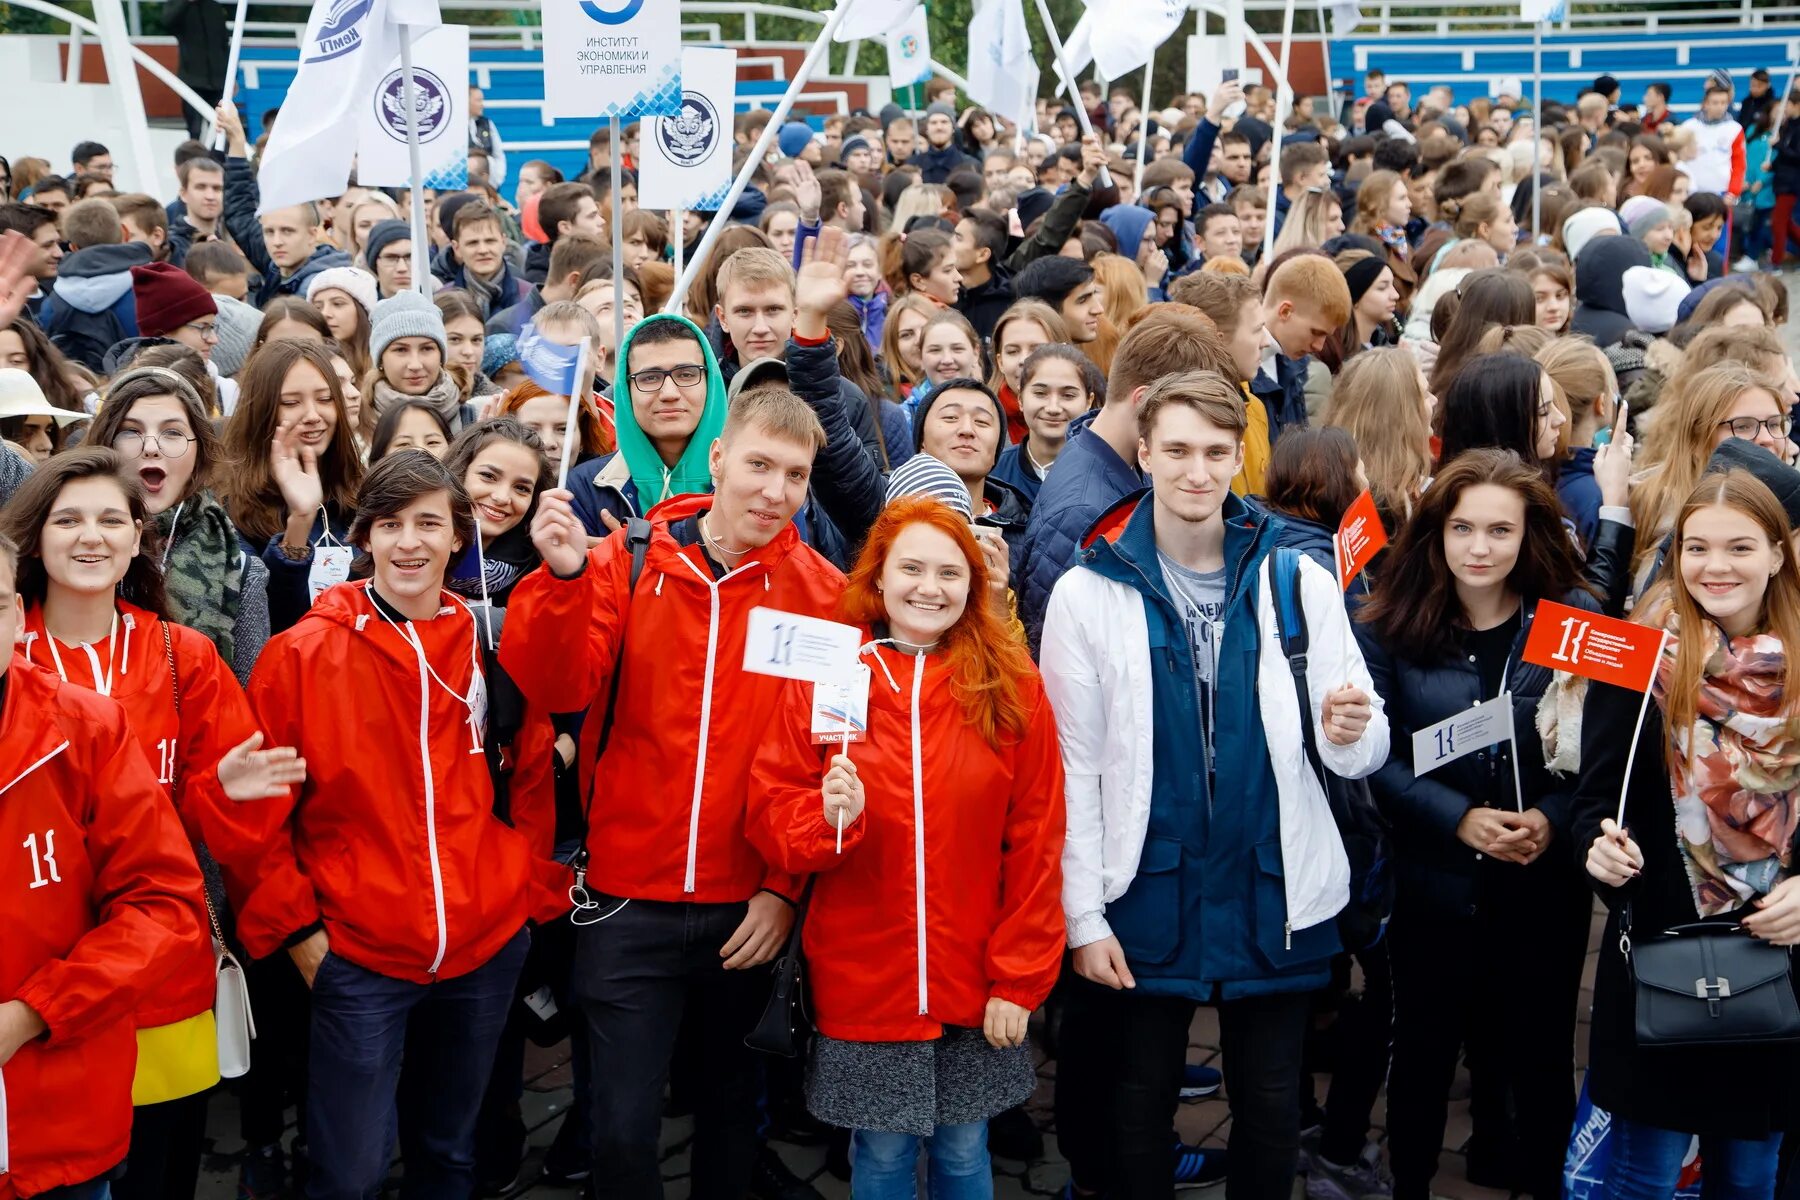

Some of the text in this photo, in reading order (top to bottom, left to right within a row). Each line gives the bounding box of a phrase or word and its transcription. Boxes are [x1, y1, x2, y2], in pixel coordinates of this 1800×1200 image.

[586, 36, 638, 47] ИНСТИТУТ
[577, 50, 649, 61] ЭКОНОМИКИ И
[580, 64, 646, 75] УПРАВЛЕНИЯ
[1186, 602, 1222, 618] WHEN
